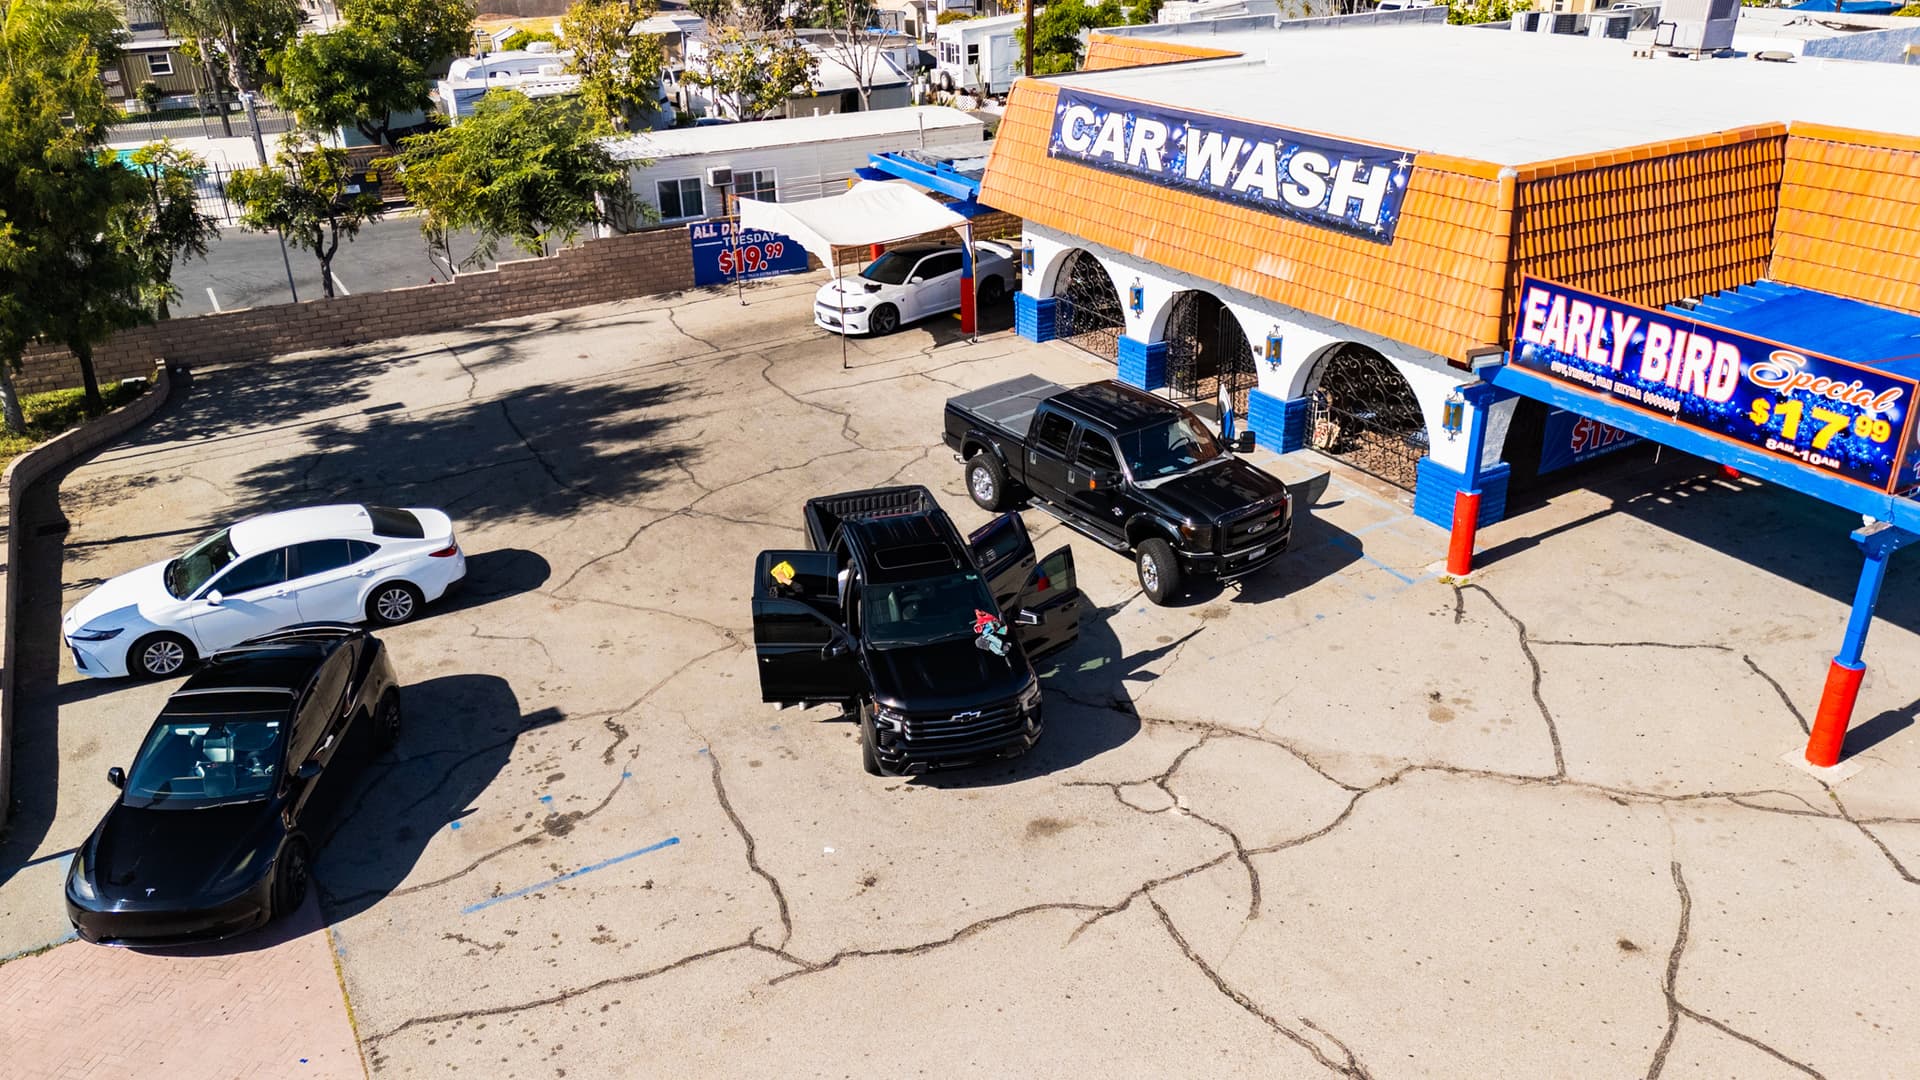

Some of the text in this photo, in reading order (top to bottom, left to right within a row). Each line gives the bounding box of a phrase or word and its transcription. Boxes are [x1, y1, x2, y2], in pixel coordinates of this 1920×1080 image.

[1060, 104, 1392, 225] CAR WASH
[693, 224, 718, 239] ALL
[721, 222, 744, 236] DA
[723, 232, 775, 247] TUESDAY
[1522, 287, 1741, 403] EARLY BIRD
[1748, 350, 1904, 413] Special
